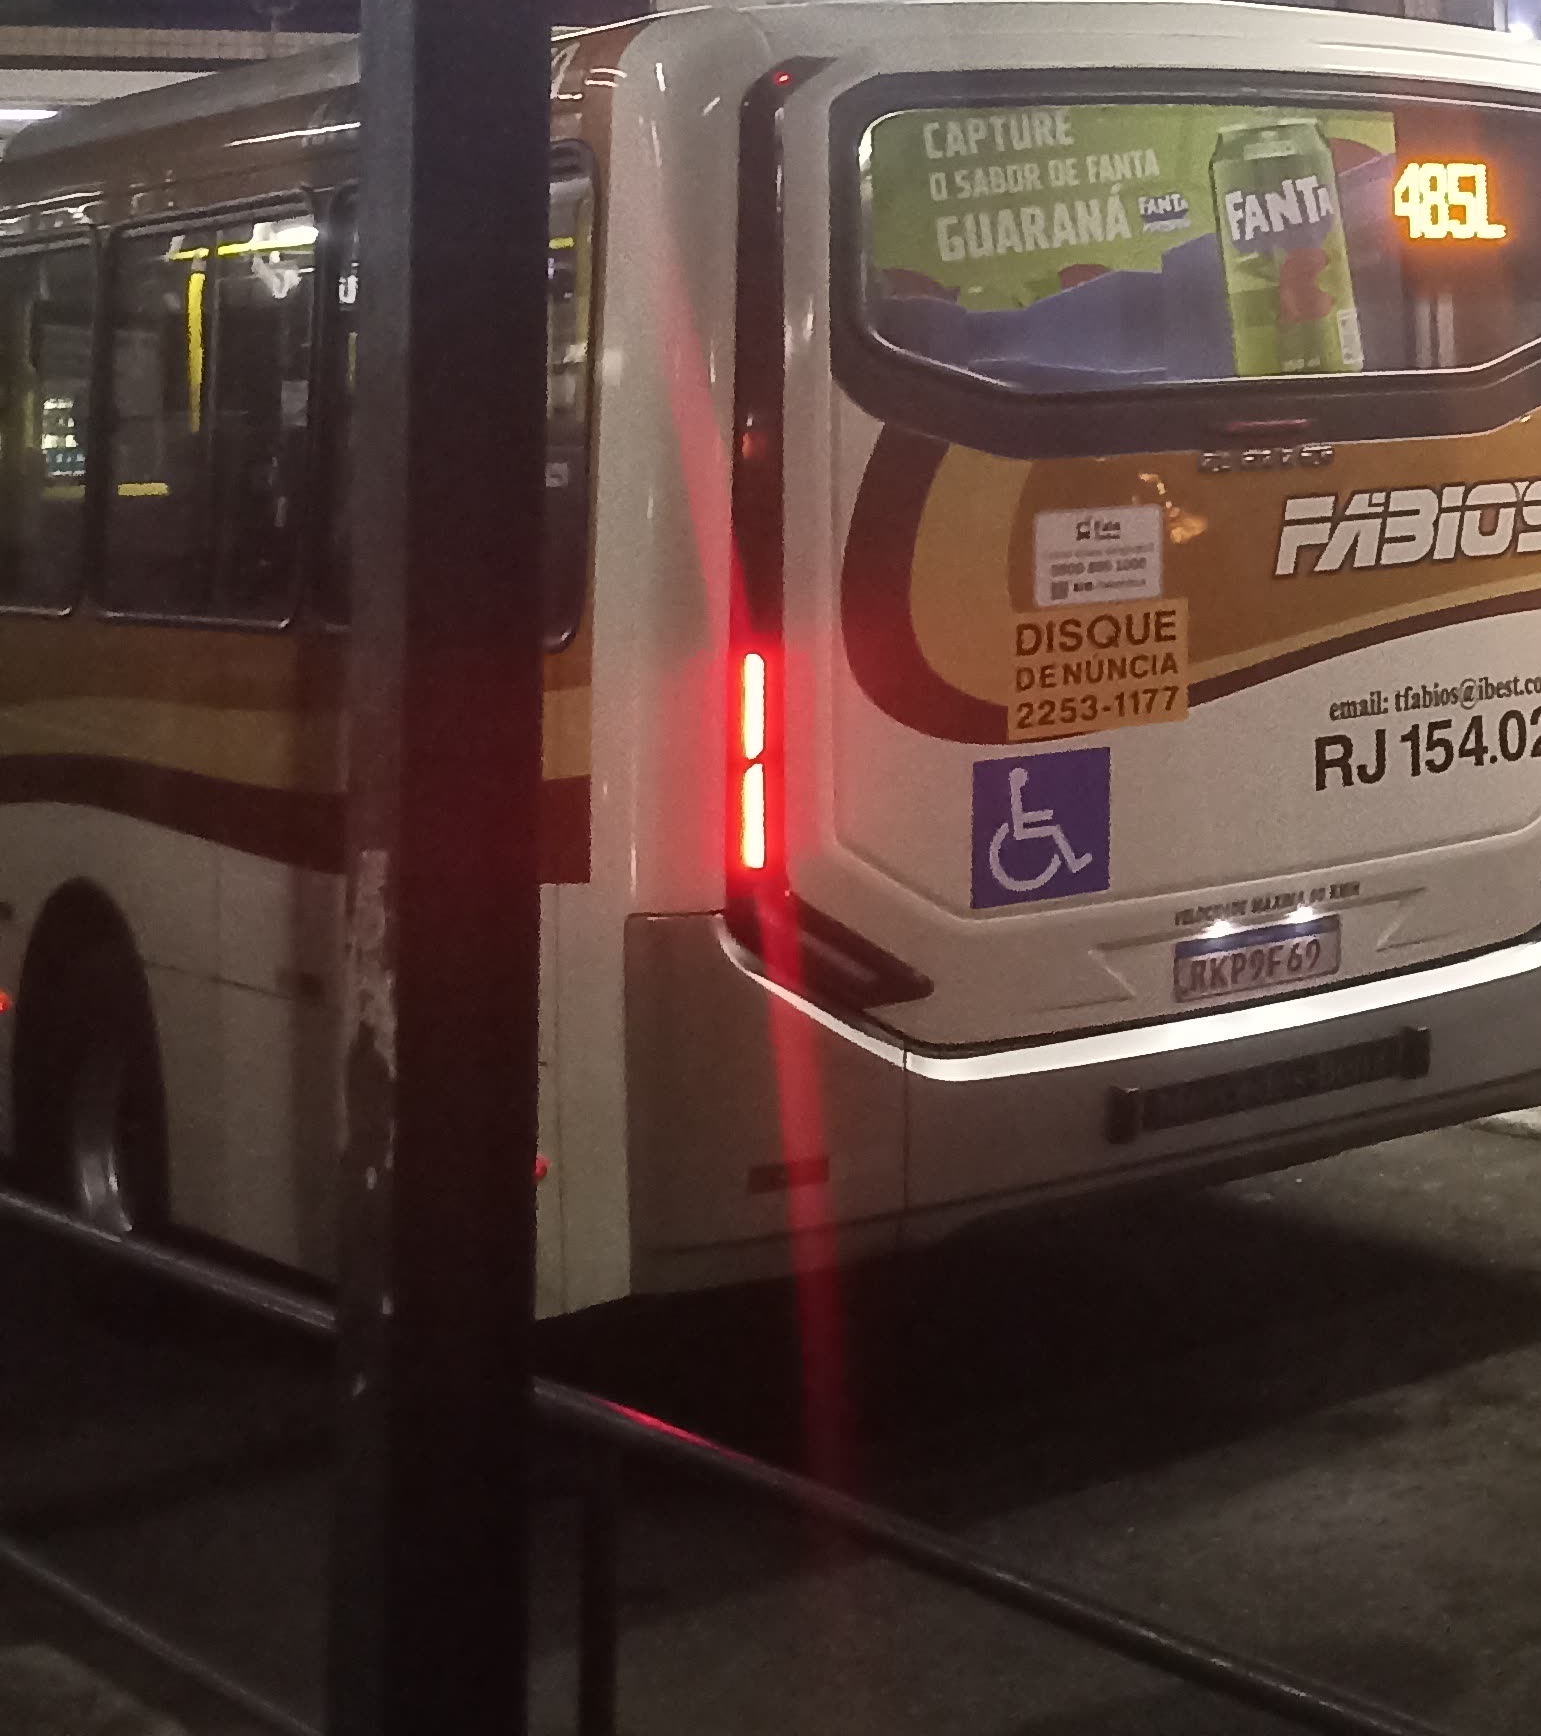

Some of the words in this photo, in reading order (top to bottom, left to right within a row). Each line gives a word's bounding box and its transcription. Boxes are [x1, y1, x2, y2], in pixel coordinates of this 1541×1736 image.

[922, 108, 1076, 160] CAPTURE
[928, 171, 949, 202] O
[953, 162, 1044, 200] SABOR
[1047, 157, 1081, 189] DE
[1084, 147, 1162, 184] FANTA
[1393, 161, 1507, 239] 485L
[936, 181, 1134, 263] GUARANÁ
[1224, 174, 1336, 242] FANTA
[1014, 610, 1179, 659] DISQUE
[1014, 650, 1180, 693] DENÚNCIA
[1015, 684, 1181, 730] 2253-1177
[1328, 691, 1389, 721] email:
[1314, 729, 1387, 792] RJ
